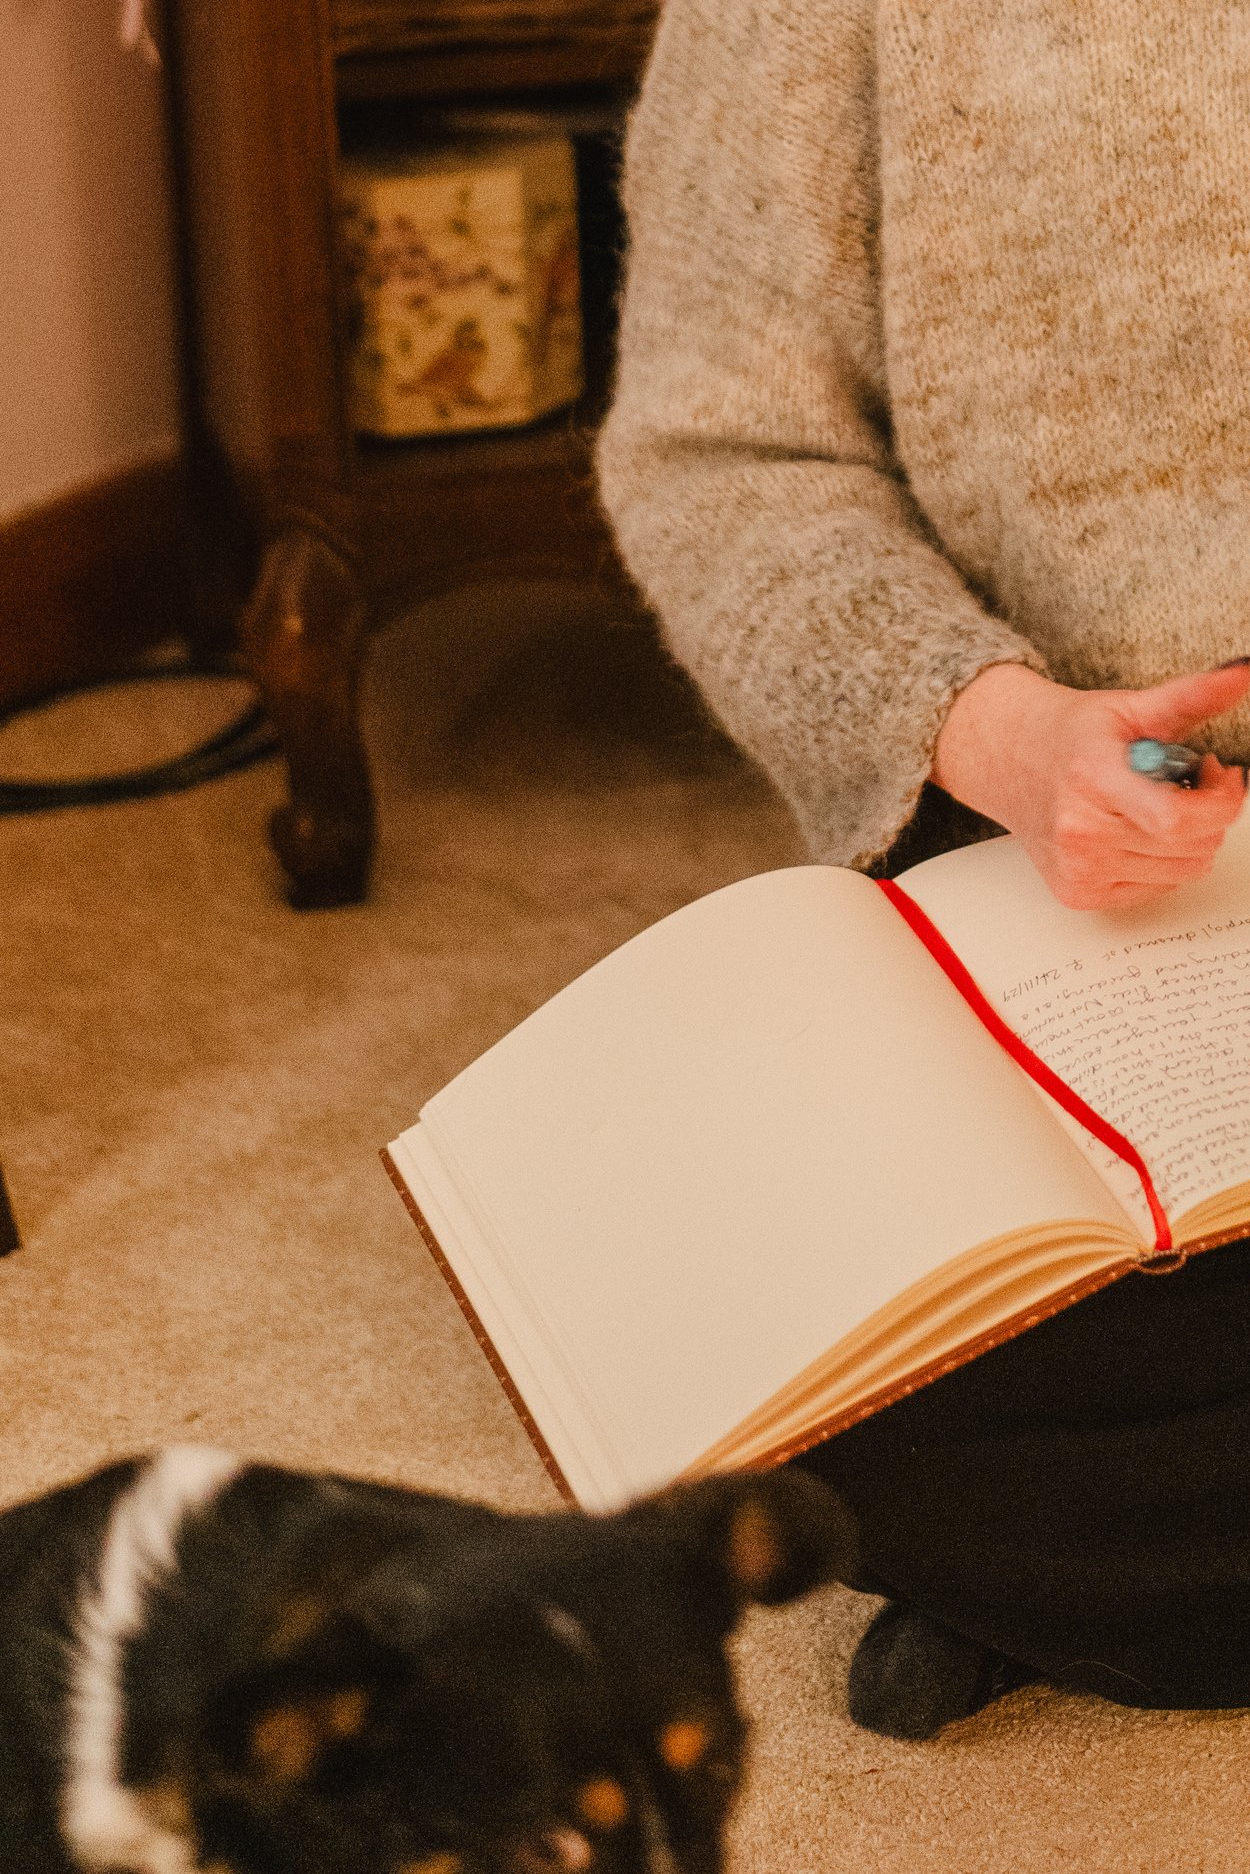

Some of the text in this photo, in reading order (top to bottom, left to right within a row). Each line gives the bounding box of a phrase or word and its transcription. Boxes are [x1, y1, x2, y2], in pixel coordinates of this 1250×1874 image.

[1122, 929, 1197, 955] dreamed
[1069, 997, 1104, 1017] Not
[1165, 999, 1212, 1015] how
[1109, 1011, 1202, 1049] younger
[1104, 1047, 1144, 1066] how
[1154, 1040, 1219, 1059] think
[1160, 1063, 1215, 1081] King
[1102, 1078, 1165, 1108] knows
